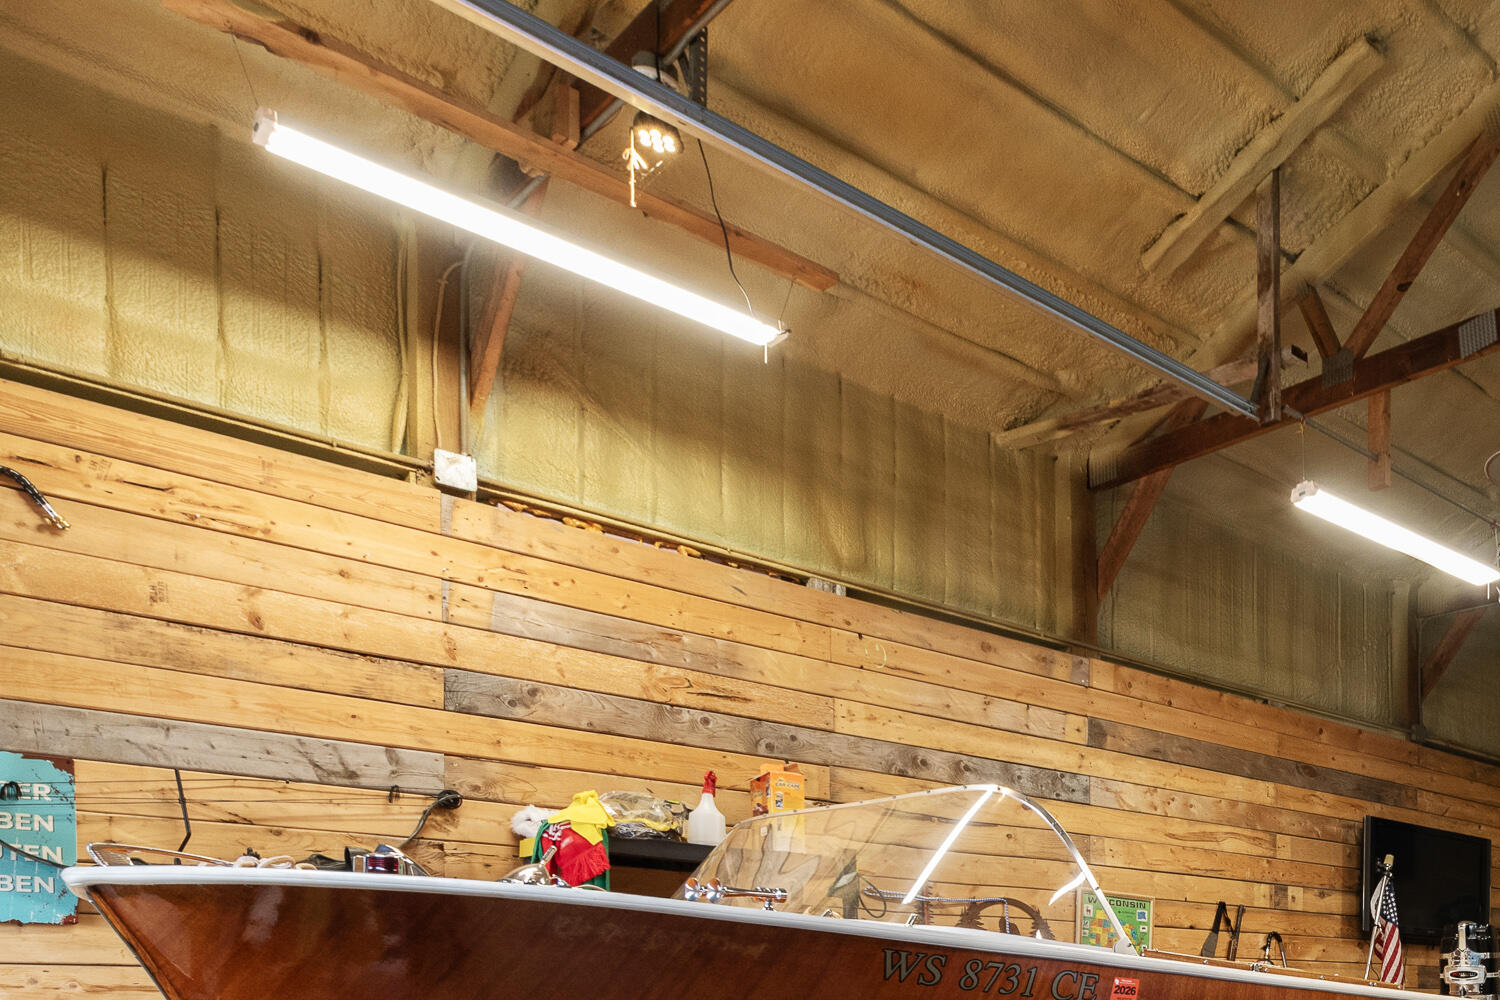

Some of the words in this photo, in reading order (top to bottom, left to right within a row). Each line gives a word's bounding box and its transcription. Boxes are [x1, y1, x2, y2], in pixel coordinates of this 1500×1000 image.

[0, 844, 64, 866] TEN
[1087, 896, 1147, 910] WCONSIN
[882, 948, 948, 987] WS
[958, 958, 1039, 998] 8731
[1113, 984, 1137, 996] 2026
